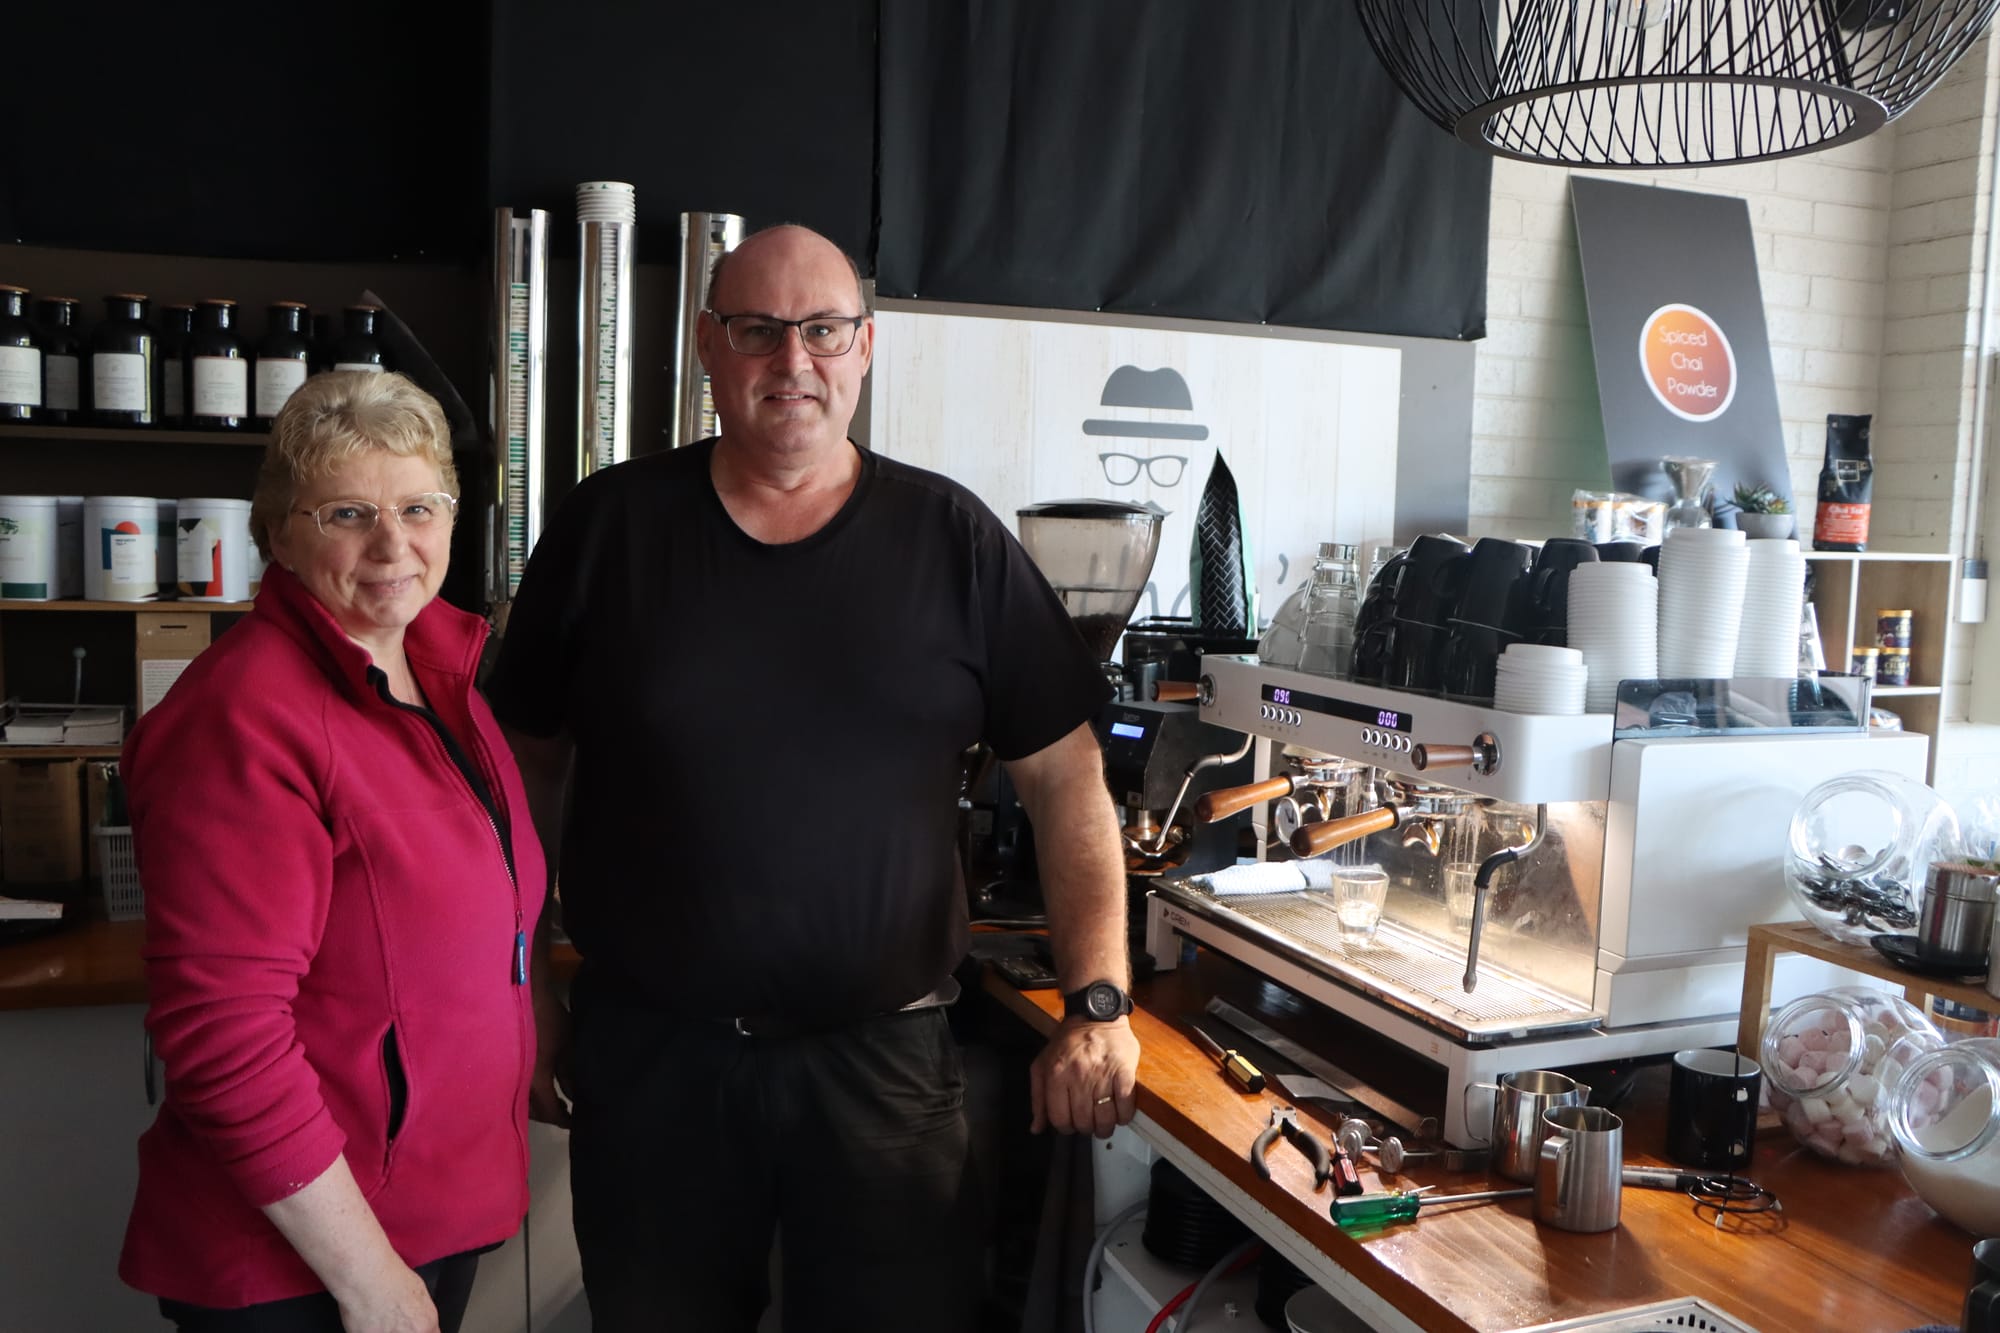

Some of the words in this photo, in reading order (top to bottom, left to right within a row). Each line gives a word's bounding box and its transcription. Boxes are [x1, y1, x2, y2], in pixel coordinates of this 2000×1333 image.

[1659, 325, 1708, 346] Spiced
[1670, 351, 1704, 371] Chai
[1666, 377, 1718, 397] Powder
[1378, 710, 1398, 728] 000
